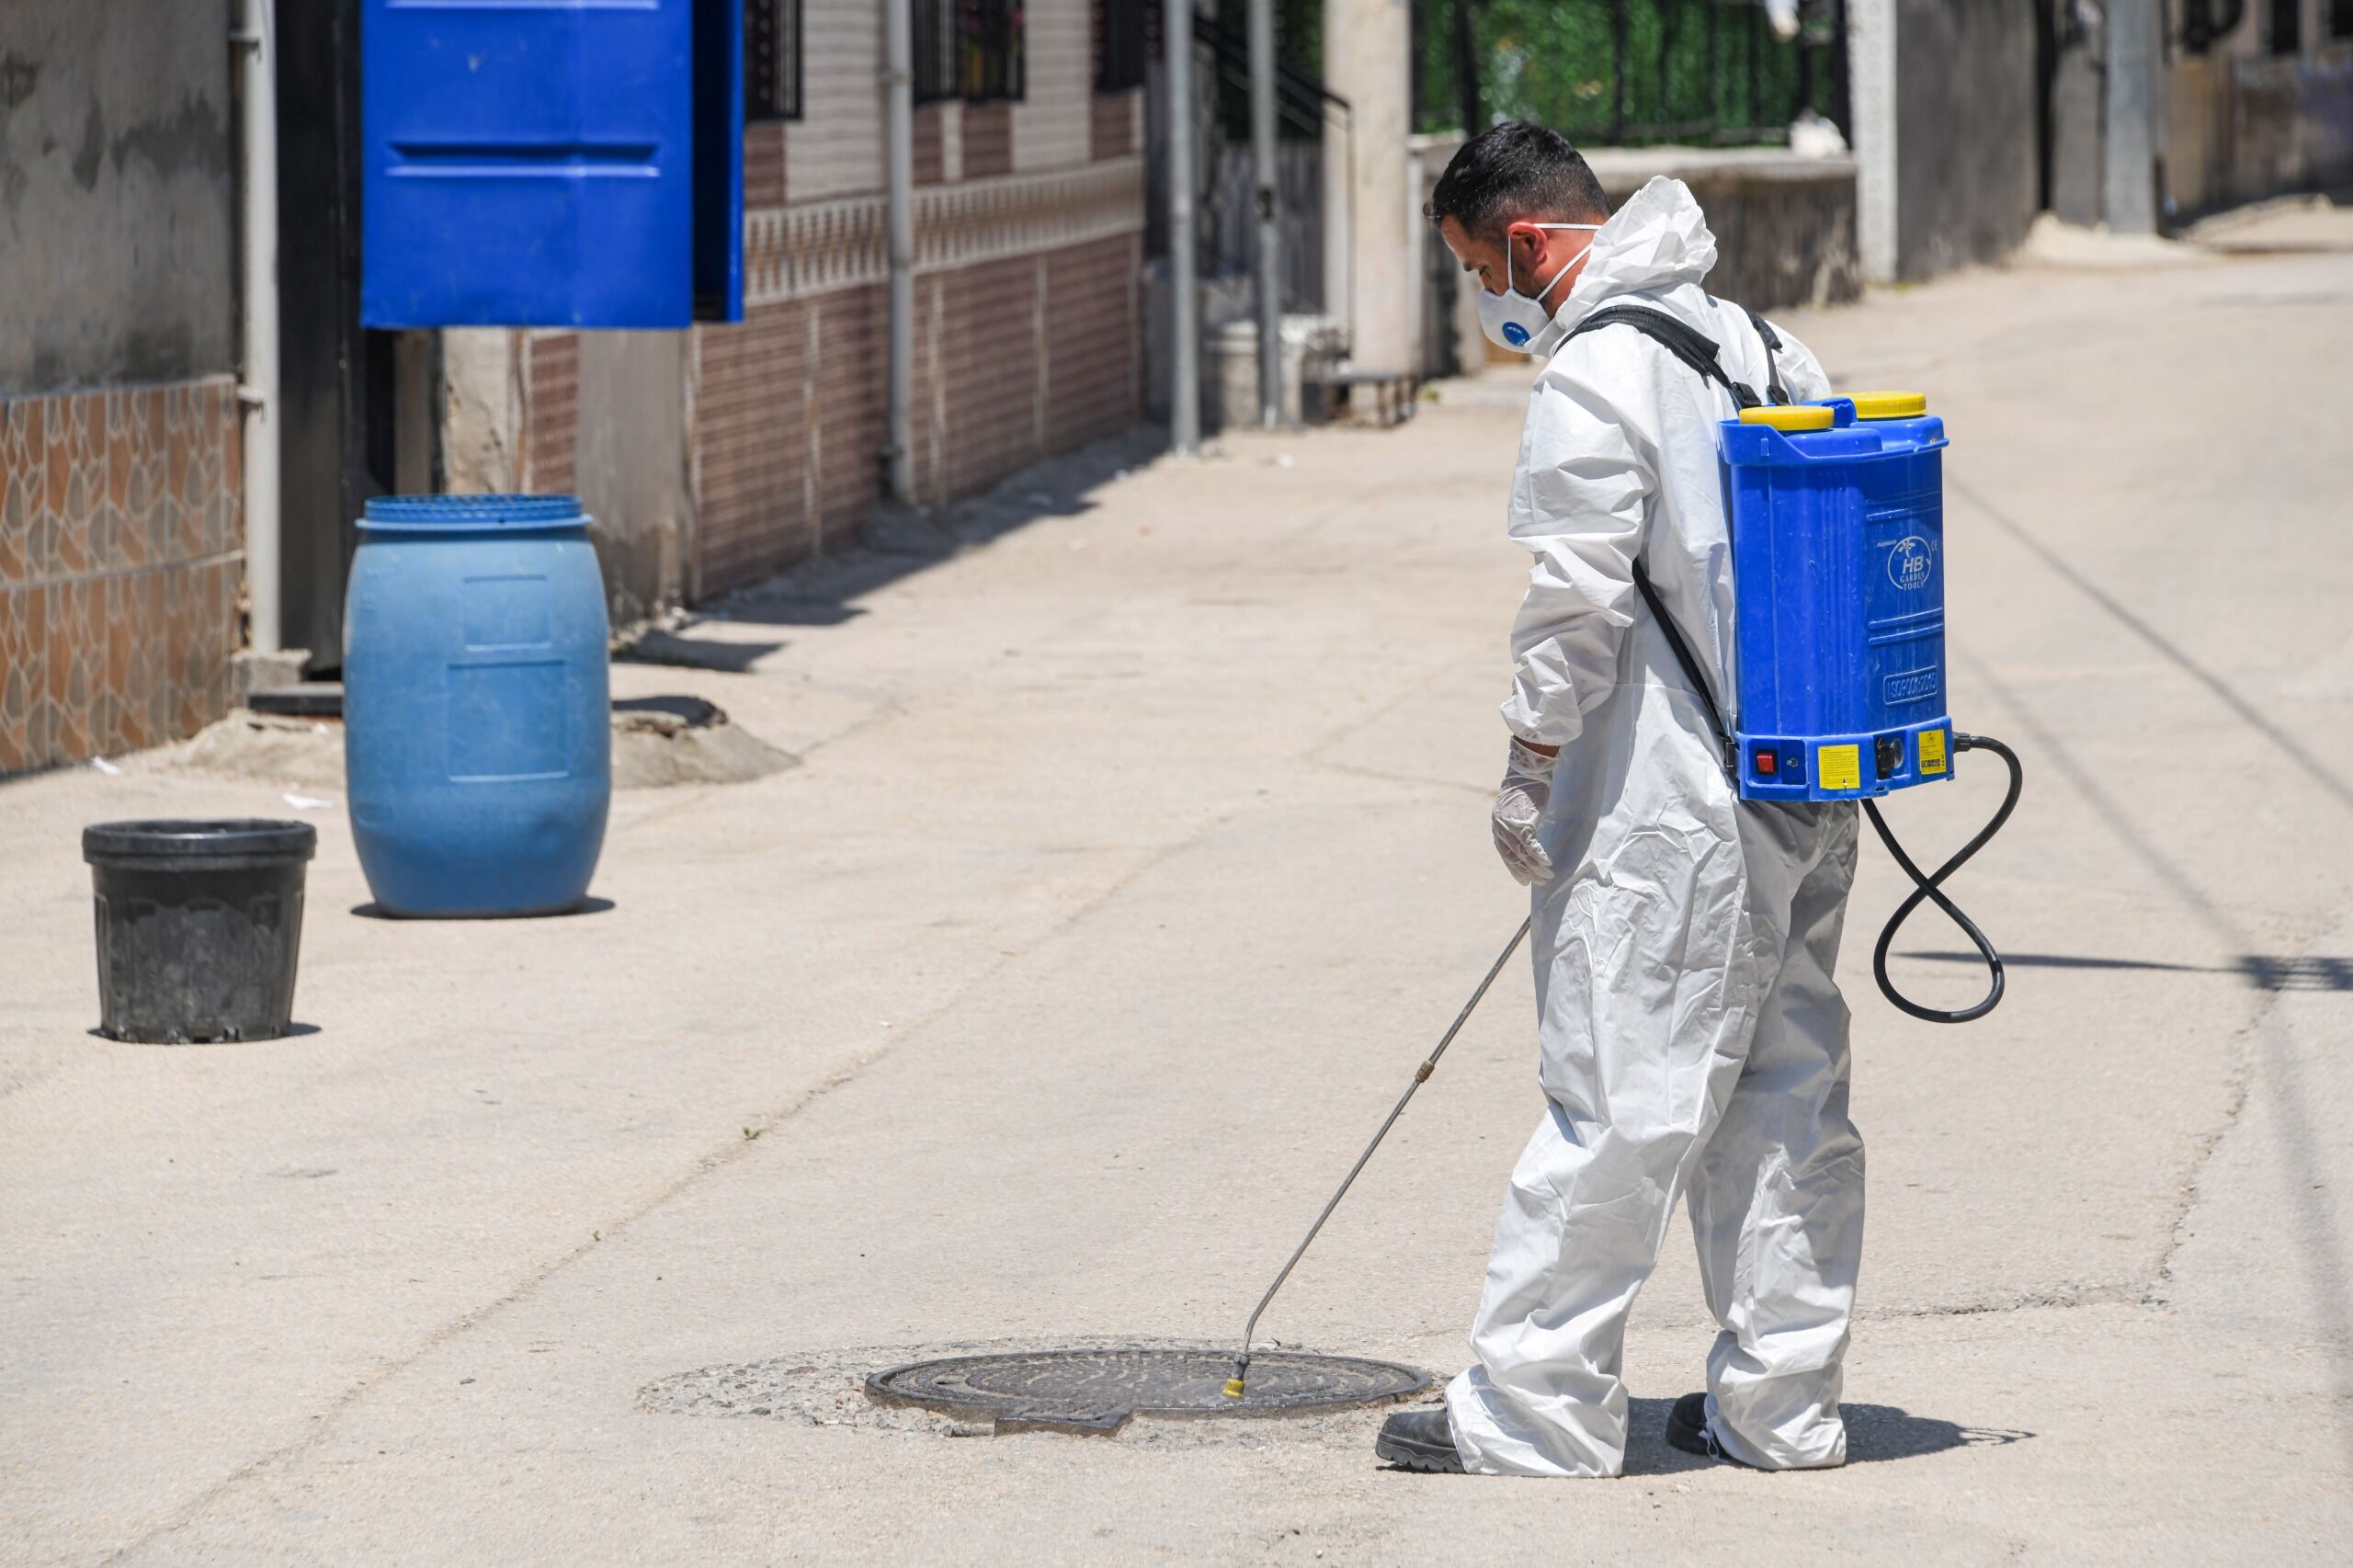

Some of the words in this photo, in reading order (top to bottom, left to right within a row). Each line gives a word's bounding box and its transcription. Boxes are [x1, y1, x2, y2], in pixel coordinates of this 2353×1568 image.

[1902, 555, 1924, 574] HB
[1900, 572, 1925, 584] GARDEN
[1903, 580, 1925, 591] TOOLS
